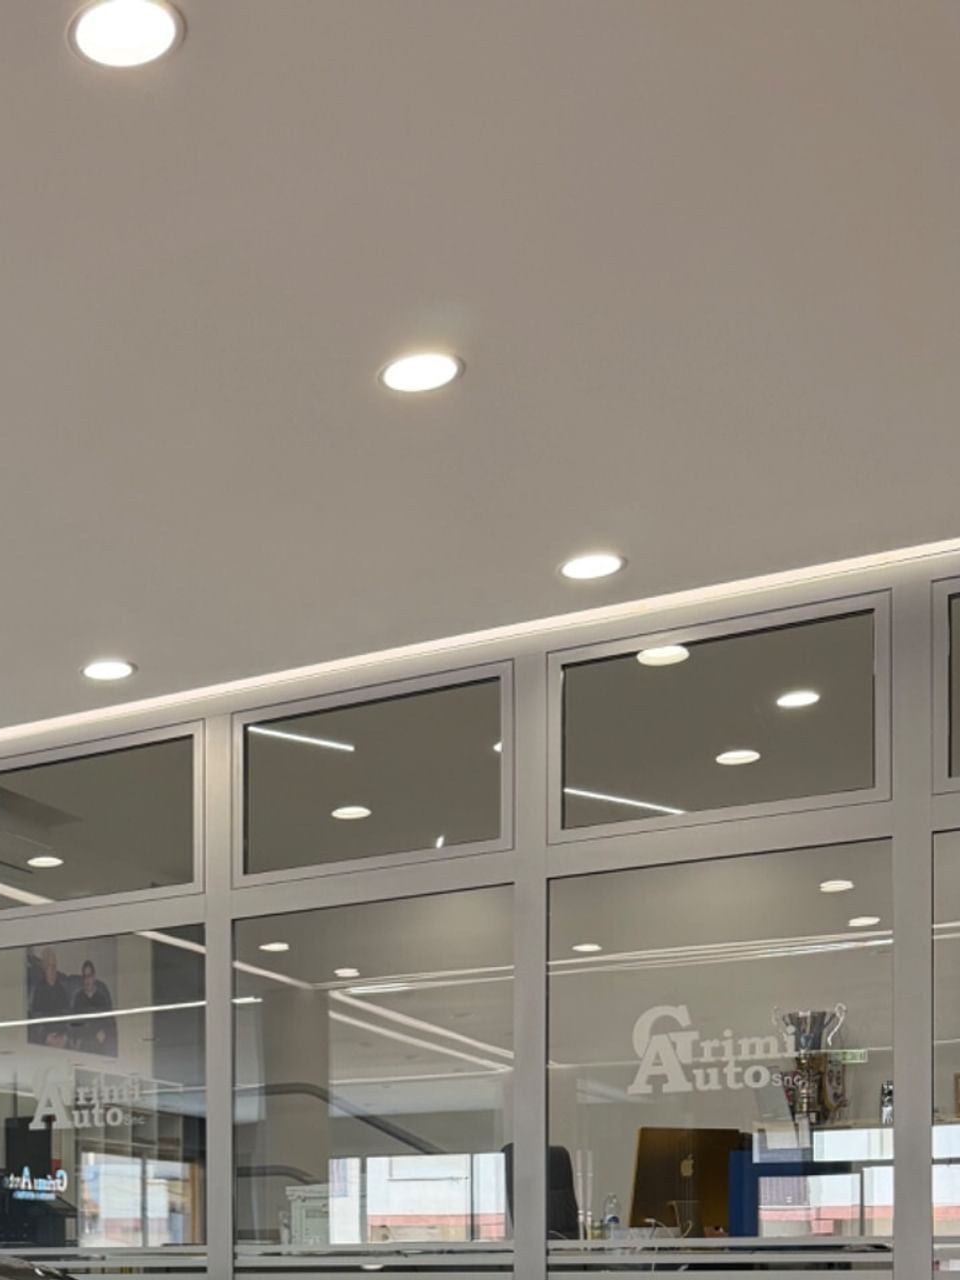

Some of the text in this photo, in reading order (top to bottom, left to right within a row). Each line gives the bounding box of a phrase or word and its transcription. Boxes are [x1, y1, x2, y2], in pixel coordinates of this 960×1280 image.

[627, 1033, 770, 1095] Auto
[632, 1004, 799, 1065] Grimi
[28, 1080, 124, 1131] Auto
